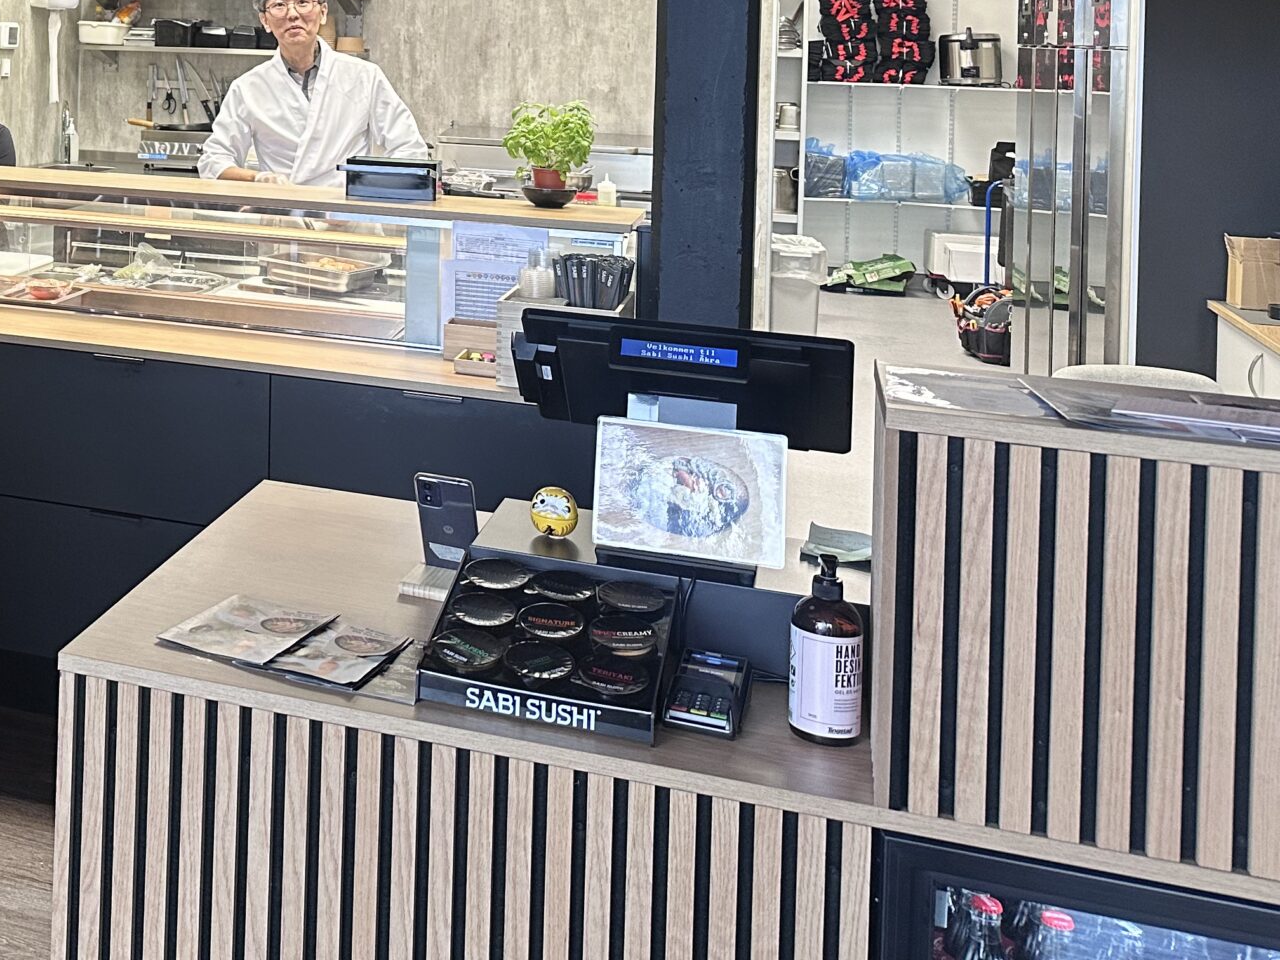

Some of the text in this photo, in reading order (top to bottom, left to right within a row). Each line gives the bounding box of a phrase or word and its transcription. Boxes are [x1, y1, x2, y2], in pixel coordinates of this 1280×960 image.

[640, 350, 662, 358] Sabi
[667, 352, 693, 361] Sushi
[646, 342, 715, 356] Velkommen til
[527, 615, 577, 627] SIGNATURE
[835, 643, 861, 659] HAND
[591, 666, 635, 682] TERIYAKI
[465, 687, 596, 731] SABI SUSHI
